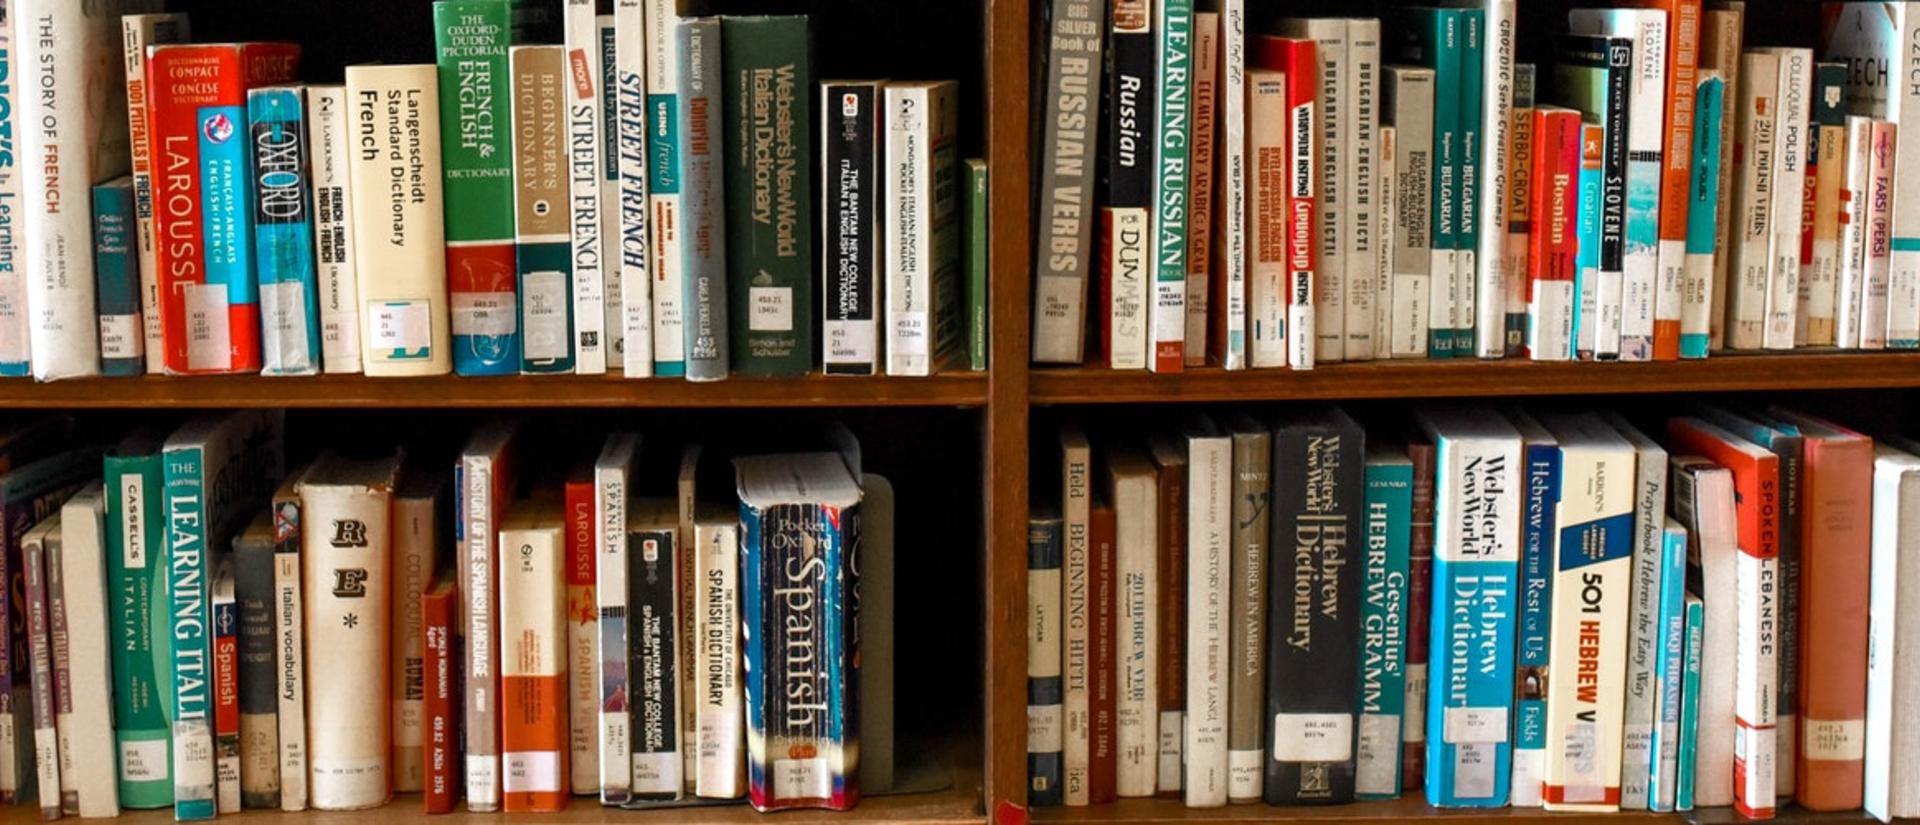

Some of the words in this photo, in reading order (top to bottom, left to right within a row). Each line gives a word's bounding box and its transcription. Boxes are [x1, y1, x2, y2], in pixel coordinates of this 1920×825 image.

[39, 14, 53, 48] THE
[460, 15, 485, 24] THE
[1058, 21, 1096, 36] SILVER
[1067, 5, 1088, 18] BIG
[442, 45, 506, 57] PICTORIAL
[452, 36, 495, 46] DUDEN
[1643, 22, 1655, 80] SLOVENE
[40, 53, 55, 111] STORY
[129, 79, 143, 105] 1001
[170, 66, 220, 78] COMPACT
[172, 82, 219, 95] CONCISE
[474, 60, 494, 140] FRENCH
[574, 58, 589, 90] more
[691, 80, 702, 90] OF
[753, 69, 772, 125] Italian
[1164, 16, 1188, 149] LEARNING
[1786, 55, 1802, 123] COLLOQUIAL
[43, 116, 57, 138] OF
[131, 107, 147, 154] PITFALLS
[359, 89, 380, 161] French
[388, 89, 404, 163] Standard
[458, 60, 478, 149] ENGLISH
[521, 73, 537, 189] DICTIONARY
[541, 73, 558, 189] BEGINNER'S
[619, 71, 642, 167] STREET
[658, 102, 668, 136] USING
[776, 64, 794, 158] Webster's
[1058, 57, 1089, 176] RUSSIAN
[1119, 75, 1141, 167] Russian
[1195, 80, 1212, 165] ELEMENTARY
[1323, 61, 1338, 204] BULGARIAN-ENGLISH
[407, 89, 424, 204] Langenscheidt
[572, 105, 596, 187] STREET
[1357, 63, 1371, 205] BULGARIAN-ENGLISH
[1612, 114, 1621, 168] YOURSELF
[1757, 120, 1772, 146] 201
[1784, 126, 1799, 172] POLISH
[44, 144, 60, 214] FRENCH
[133, 159, 148, 172] IN
[256, 131, 301, 217] OXFORD
[448, 168, 512, 179] DICTIONARY
[656, 140, 673, 186] french
[752, 127, 773, 223] Dictionary
[840, 159, 849, 198] ITALIAN
[848, 169, 858, 189] THE
[1297, 159, 1309, 197] ENGLISH
[1511, 112, 1529, 217] SERBO-CROAT
[1756, 149, 1771, 193] POLISH
[135, 174, 152, 219] FRENCH
[391, 167, 407, 247] Dictionary
[622, 172, 644, 269] FRENCH
[848, 192, 858, 237] BANTAM
[1162, 157, 1184, 266] RUSSIAN
[1258, 147, 1270, 262] ENGLISH-BYELORUSSIAN
[1269, 147, 1281, 262] BYELORUSSIAN-ENGLISH
[1399, 172, 1408, 228] DICTIONARY
[1407, 151, 1418, 248] ENGLISH-BULGARIAN
[1416, 151, 1427, 248] BULGARIAN-ENGLISH
[1440, 165, 1452, 234] BULGARIAN
[1461, 165, 1474, 233] BULGARIAN
[1551, 173, 1568, 244] Bosnian
[1583, 182, 1597, 234] Croatian
[1604, 176, 1622, 242] SLOVENE
[1754, 198, 1769, 237] VERBS
[1875, 176, 1890, 213] FARSI
[839, 210, 849, 257] ENGLISH
[848, 239, 858, 261] NEW
[908, 196, 917, 272] ITALIAN-ENGLISH
[1049, 186, 1081, 271] VERBS
[1293, 201, 1313, 268] dictionary
[848, 264, 858, 312] COLLEGE
[169, 462, 196, 474] THE
[1069, 462, 1084, 499] Held
[1322, 436, 1340, 511] Webster's
[1464, 456, 1482, 500] New
[1530, 462, 1549, 528] Hebrew
[127, 485, 140, 559] CASSELL'S
[471, 472, 485, 522] HISTORY
[606, 483, 618, 554] SPANISH
[1482, 454, 1506, 556] Webster's
[1640, 481, 1658, 555] Prayerbook
[1761, 480, 1774, 553] SPOKEN
[472, 523, 486, 537] OF
[575, 502, 589, 580] LAROUSSE
[1368, 502, 1388, 607] HEBREW
[1461, 499, 1481, 556] World
[170, 495, 202, 640] LEARNING
[472, 562, 487, 614] SPANISH
[1069, 523, 1084, 630] BEGINNING
[1208, 540, 1218, 590] HISTORY
[1247, 543, 1258, 599] HEBREW
[1286, 525, 1320, 651] Dictionary
[1320, 525, 1346, 620] Hebrew
[1581, 572, 1602, 613] 501
[1640, 559, 1654, 608] Hebrew
[124, 577, 136, 651] ITALIAN
[139, 577, 149, 651] CONTEMPORARY
[282, 587, 295, 628] italian
[708, 569, 724, 627] SPANISH
[724, 603, 733, 644] UNIVERSITY
[1035, 604, 1044, 642] LATVIAN
[1209, 593, 1218, 607] OF
[1247, 601, 1258, 616] IN
[1385, 571, 1405, 677] Gesenius'
[1527, 578, 1545, 614] Rest
[1638, 612, 1652, 633] the
[1761, 559, 1773, 656] LEBANESE
[54, 630, 68, 669] ITALIAN
[472, 615, 487, 677] LANGUAGE
[643, 605, 652, 647] SPANISH
[651, 616, 661, 634] THE
[724, 645, 733, 656] OF
[774, 556, 827, 729] Spanish
[1132, 601, 1144, 662] HEBREW
[1247, 618, 1258, 677] AMERICA
[1479, 575, 1507, 678] Hebrew
[1525, 635, 1541, 660] Us
[1527, 618, 1539, 631] OF
[1634, 636, 1651, 668] Easy
[1668, 616, 1682, 654] IRAQI
[33, 634, 48, 674] ITALIAN
[220, 643, 236, 706] Spanish
[283, 630, 297, 701] vocabulary
[577, 637, 592, 702] SPANISH
[643, 655, 653, 698] ENGLISH
[651, 636, 661, 677] BANTAM
[708, 630, 724, 706] DICTIONARY
[1208, 637, 1218, 683] HEBREW
[1576, 620, 1600, 704] HEBREW
[653, 679, 662, 701] NEW
[1633, 671, 1648, 698] Way
[1524, 706, 1539, 742] Fields
